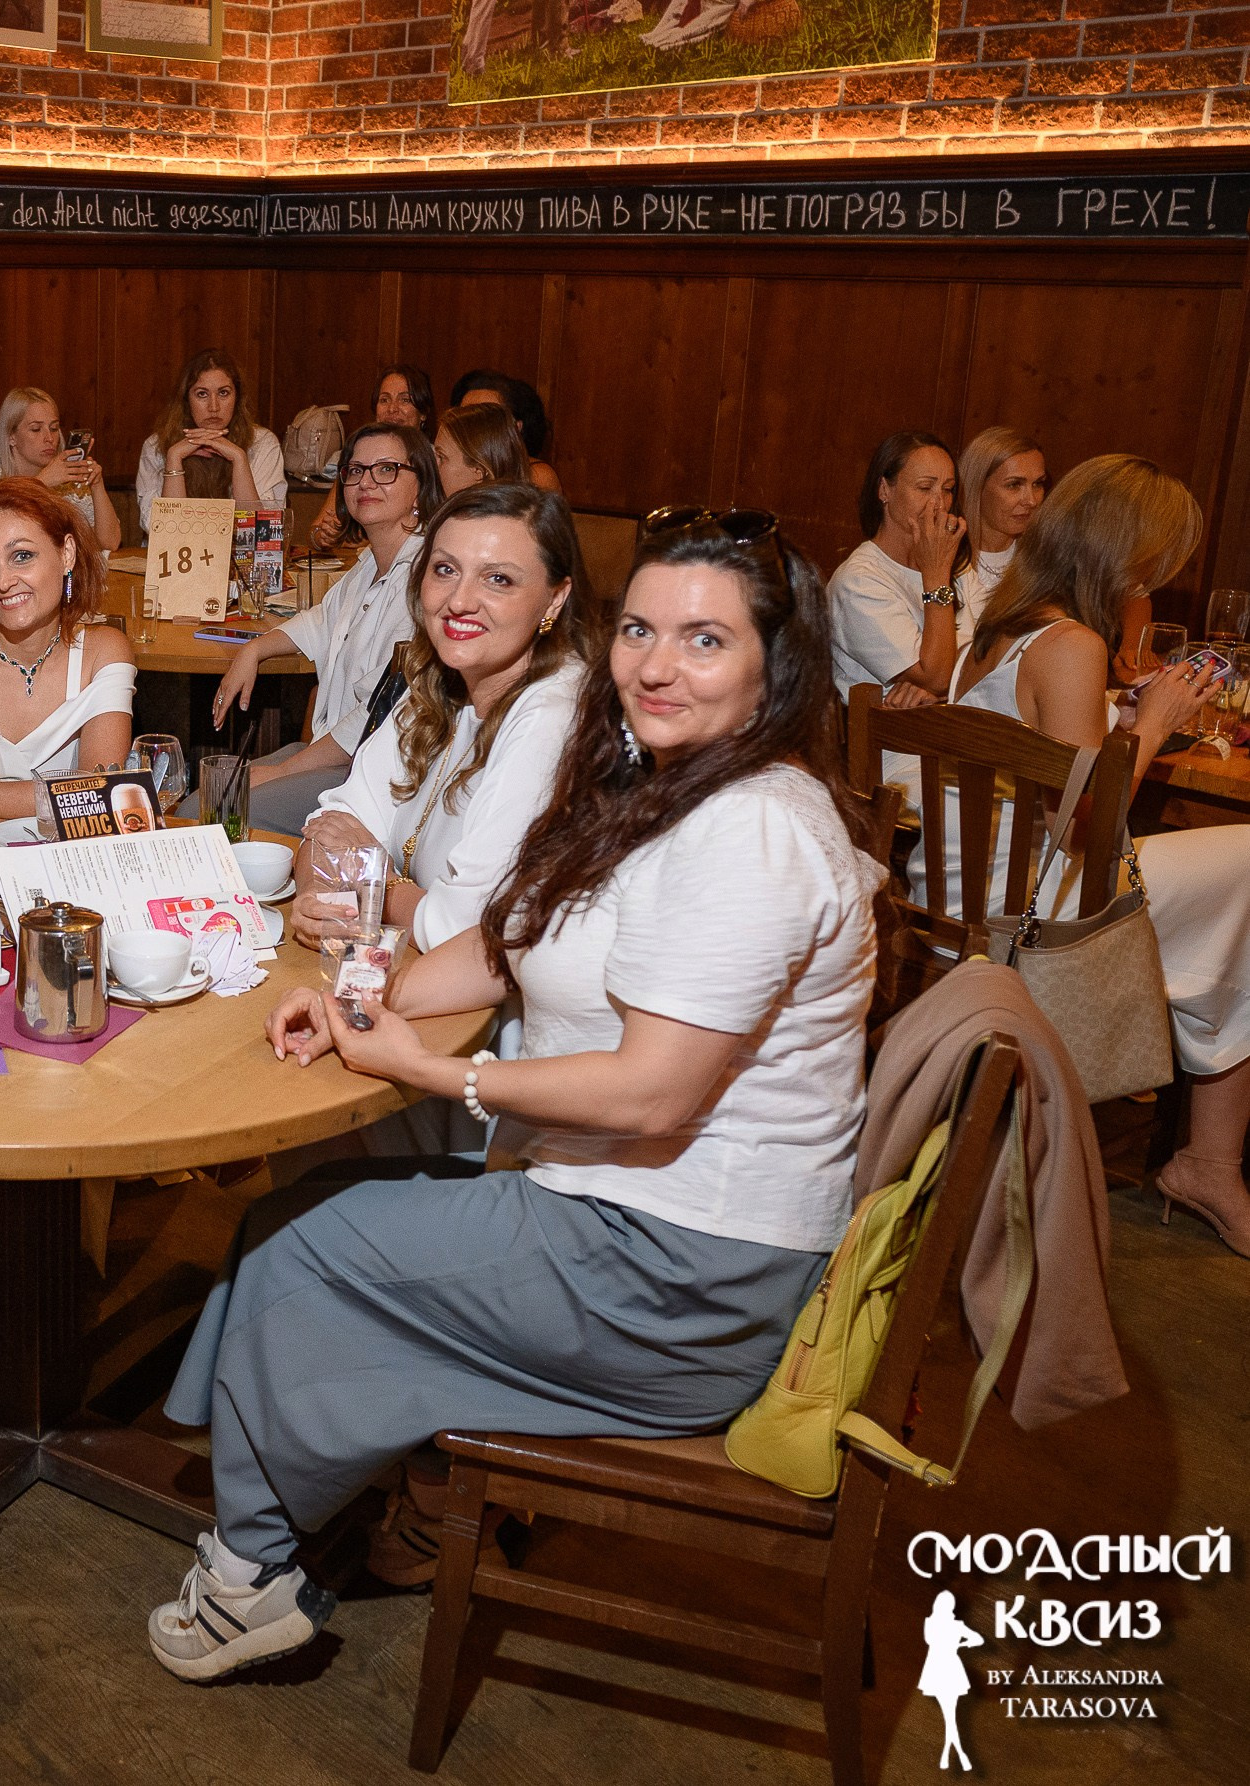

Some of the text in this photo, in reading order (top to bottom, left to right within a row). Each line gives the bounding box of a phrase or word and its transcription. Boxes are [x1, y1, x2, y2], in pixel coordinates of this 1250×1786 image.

[12, 192, 48, 227] den
[112, 193, 158, 229] nicht
[169, 198, 259, 230] gegessen!
[349, 200, 377, 231] БЫ
[447, 198, 525, 233] КРУЖКУ
[539, 194, 602, 230] ПИВА
[613, 194, 631, 228] В
[785, 190, 907, 230] ПОГРЯЗ
[919, 189, 967, 231] БЫ
[995, 187, 1021, 230] В
[1056, 176, 1217, 231] ГРЕХЕ!
[158, 546, 214, 579] 18+
[54, 779, 100, 793] ВСТРЕЧАЙТЕ!
[56, 790, 103, 808] СЕВЕРО-
[59, 801, 107, 819] НЕМЕЦКИЙ
[62, 813, 113, 839] ПИЛС
[233, 894, 255, 905] 3
